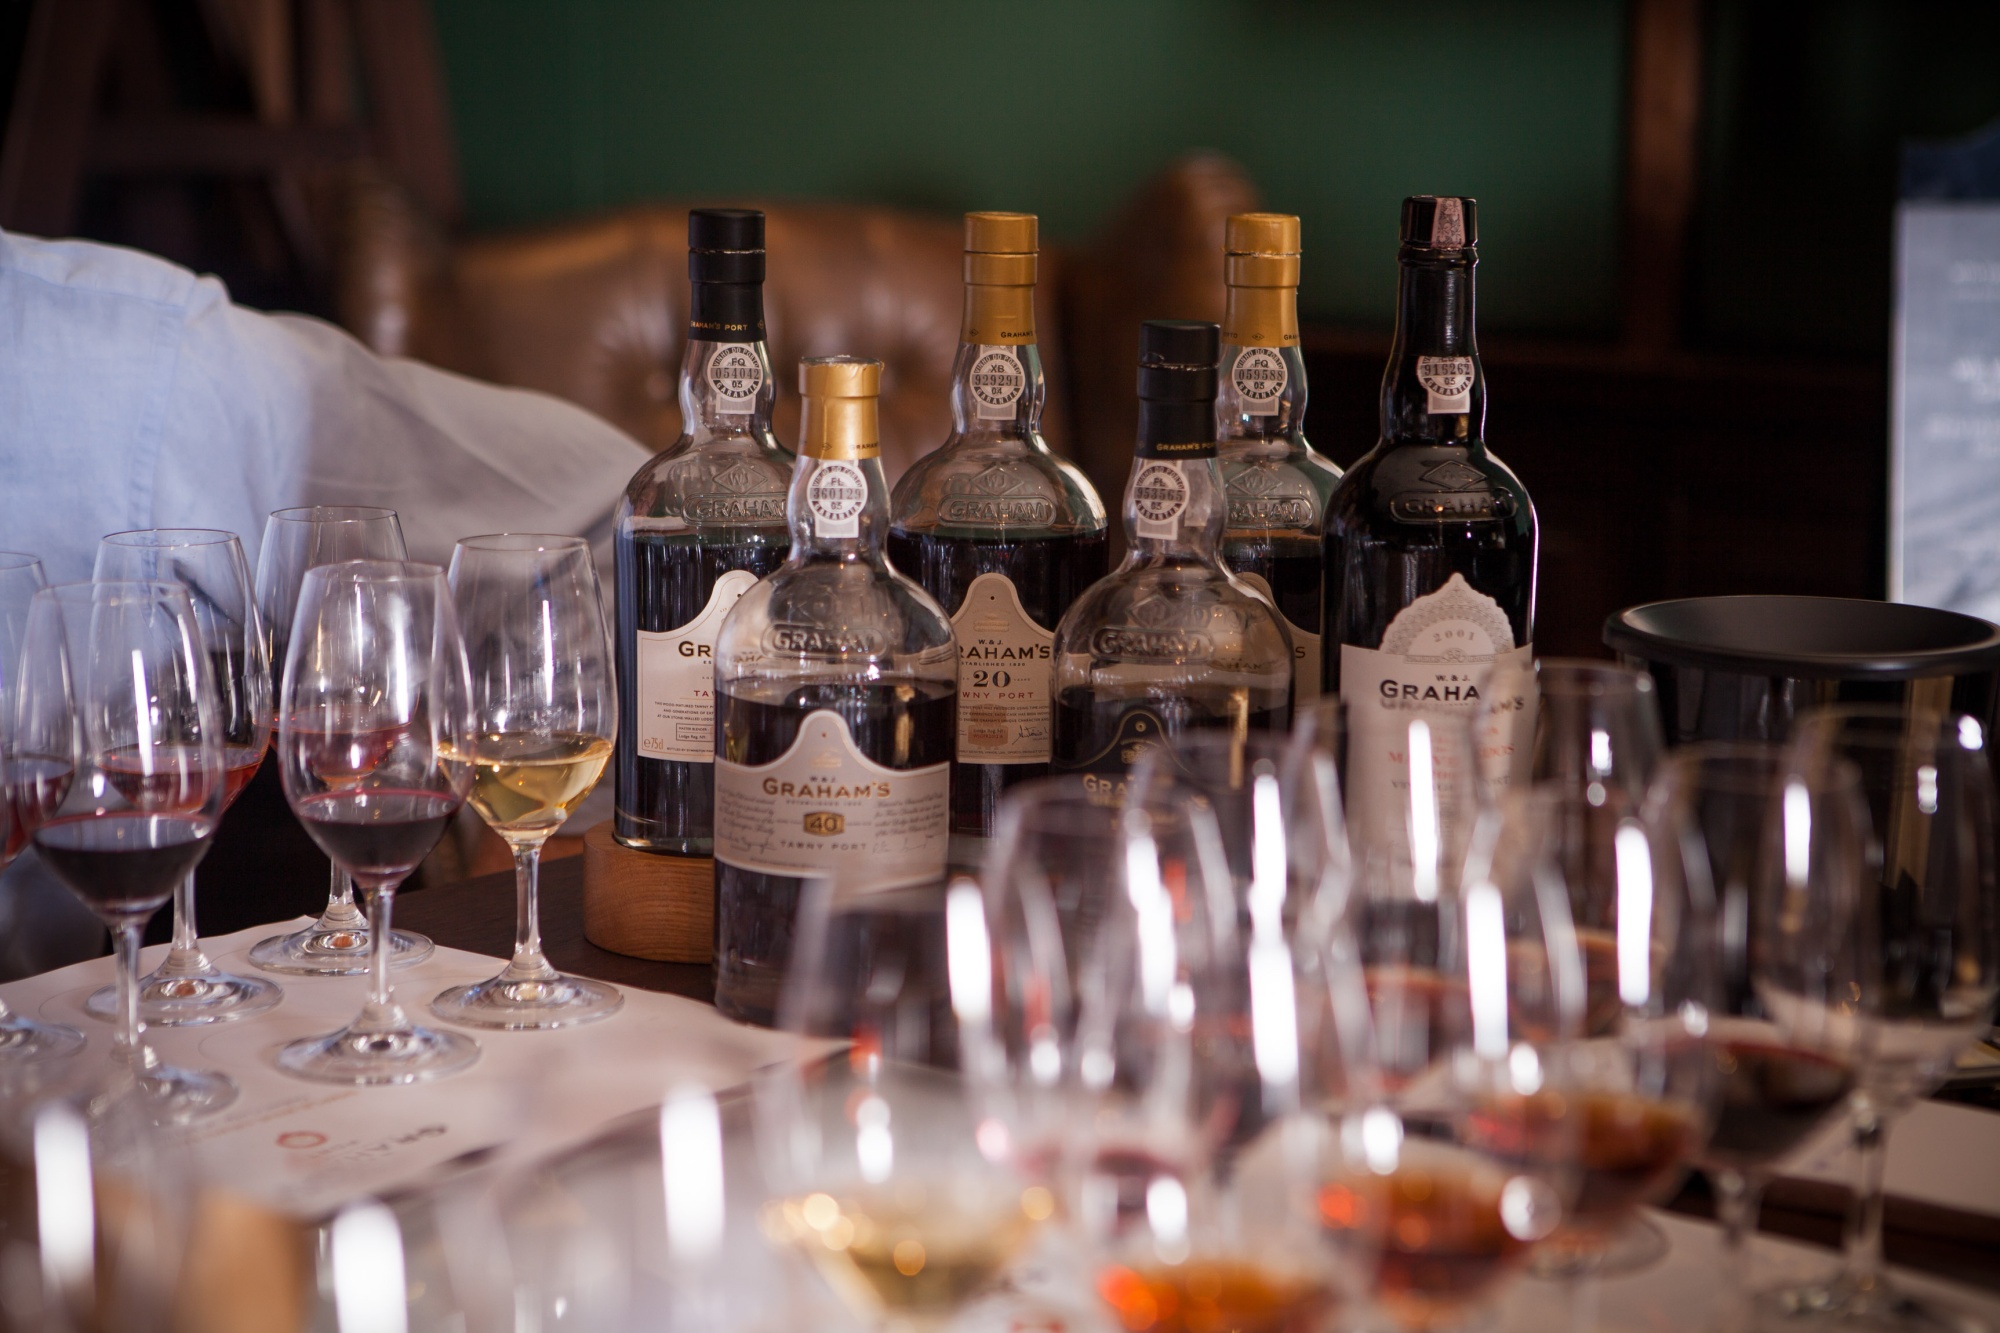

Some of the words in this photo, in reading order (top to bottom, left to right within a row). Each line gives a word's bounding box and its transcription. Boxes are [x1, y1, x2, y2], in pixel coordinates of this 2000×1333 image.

[731, 357, 746, 366] FQ
[1254, 360, 1269, 368] FQ
[715, 368, 760, 380] 054042
[990, 364, 1005, 373] XB
[975, 374, 1019, 387] 929291
[1238, 369, 1284, 381] 059588
[1156, 443, 1200, 451] GRAHAM'S
[950, 500, 1046, 521] GRAHAM
[1433, 629, 1475, 643] 2001
[973, 669, 1011, 688] 20
[1451, 674, 1458, 682] &
[762, 777, 891, 799] GRAHAM'S
[810, 816, 838, 833] 40
[780, 840, 825, 850] TAWNY
[831, 842, 867, 851] PORT
